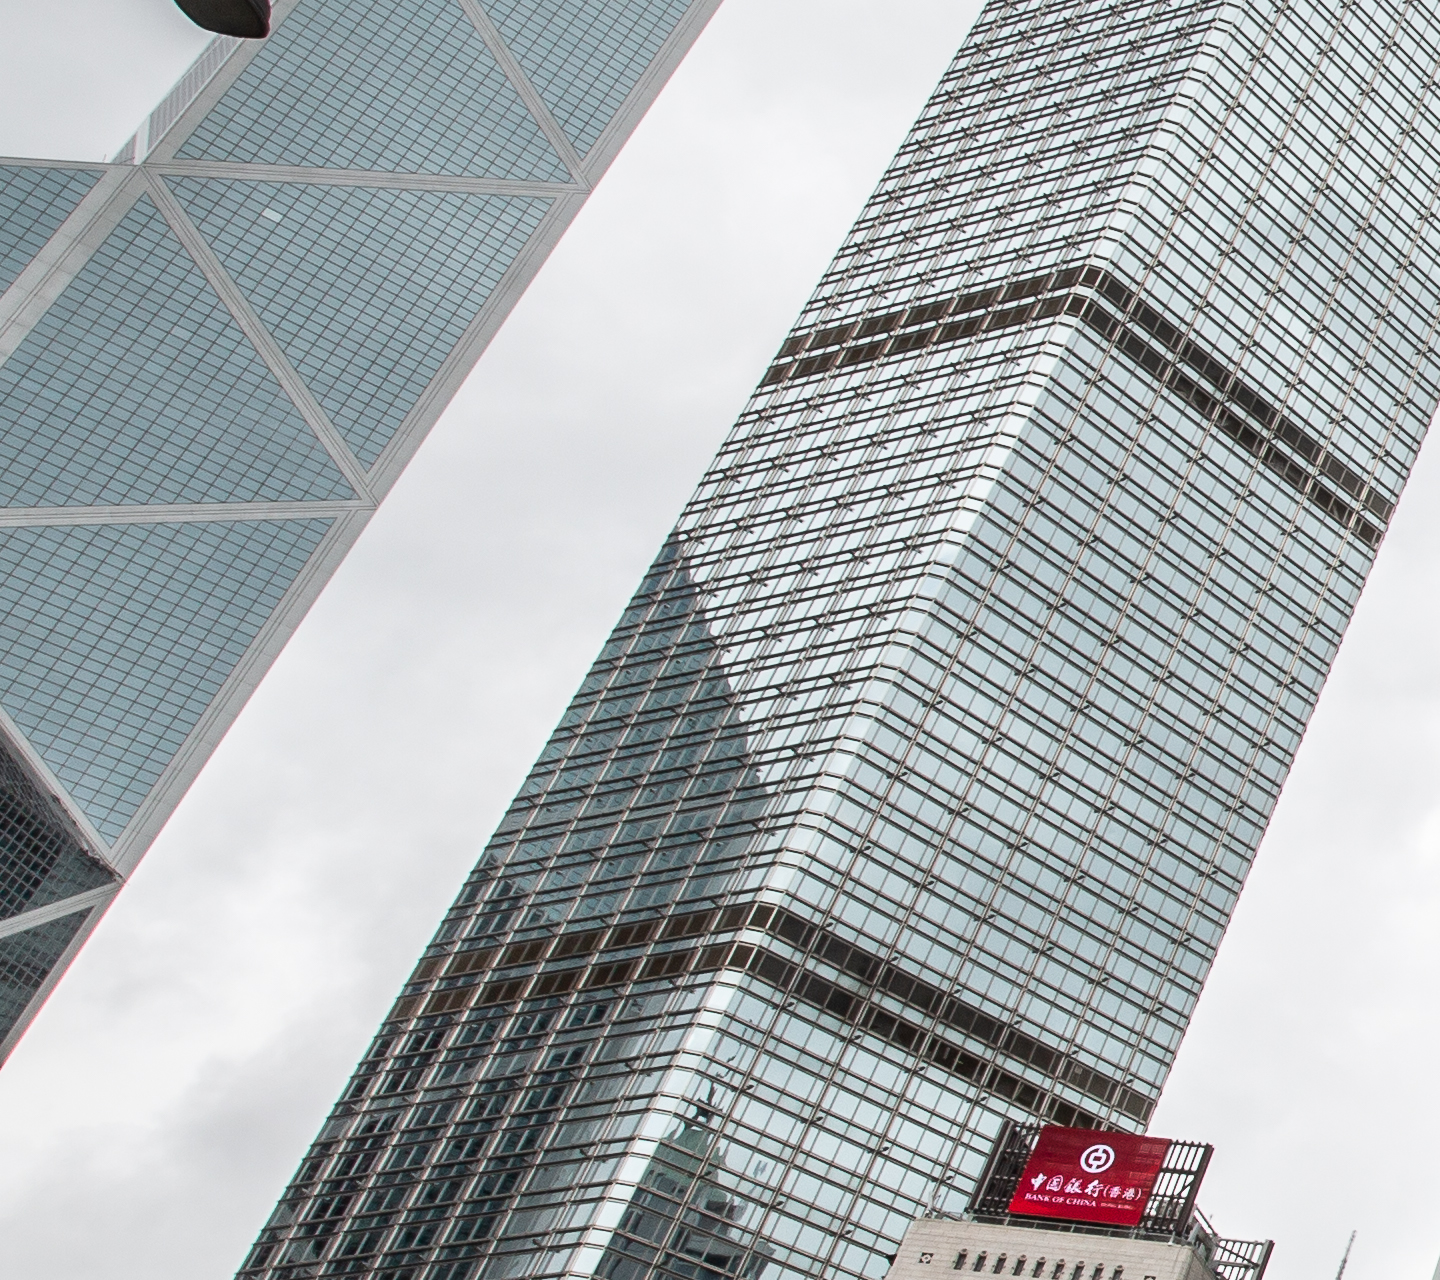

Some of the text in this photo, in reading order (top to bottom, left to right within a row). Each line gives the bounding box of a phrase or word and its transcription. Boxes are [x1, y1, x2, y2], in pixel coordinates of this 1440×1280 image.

[1024, 1192, 1050, 1203] BANK
[1051, 1195, 1065, 1204] OF
[1065, 1197, 1097, 1208] CHINA
